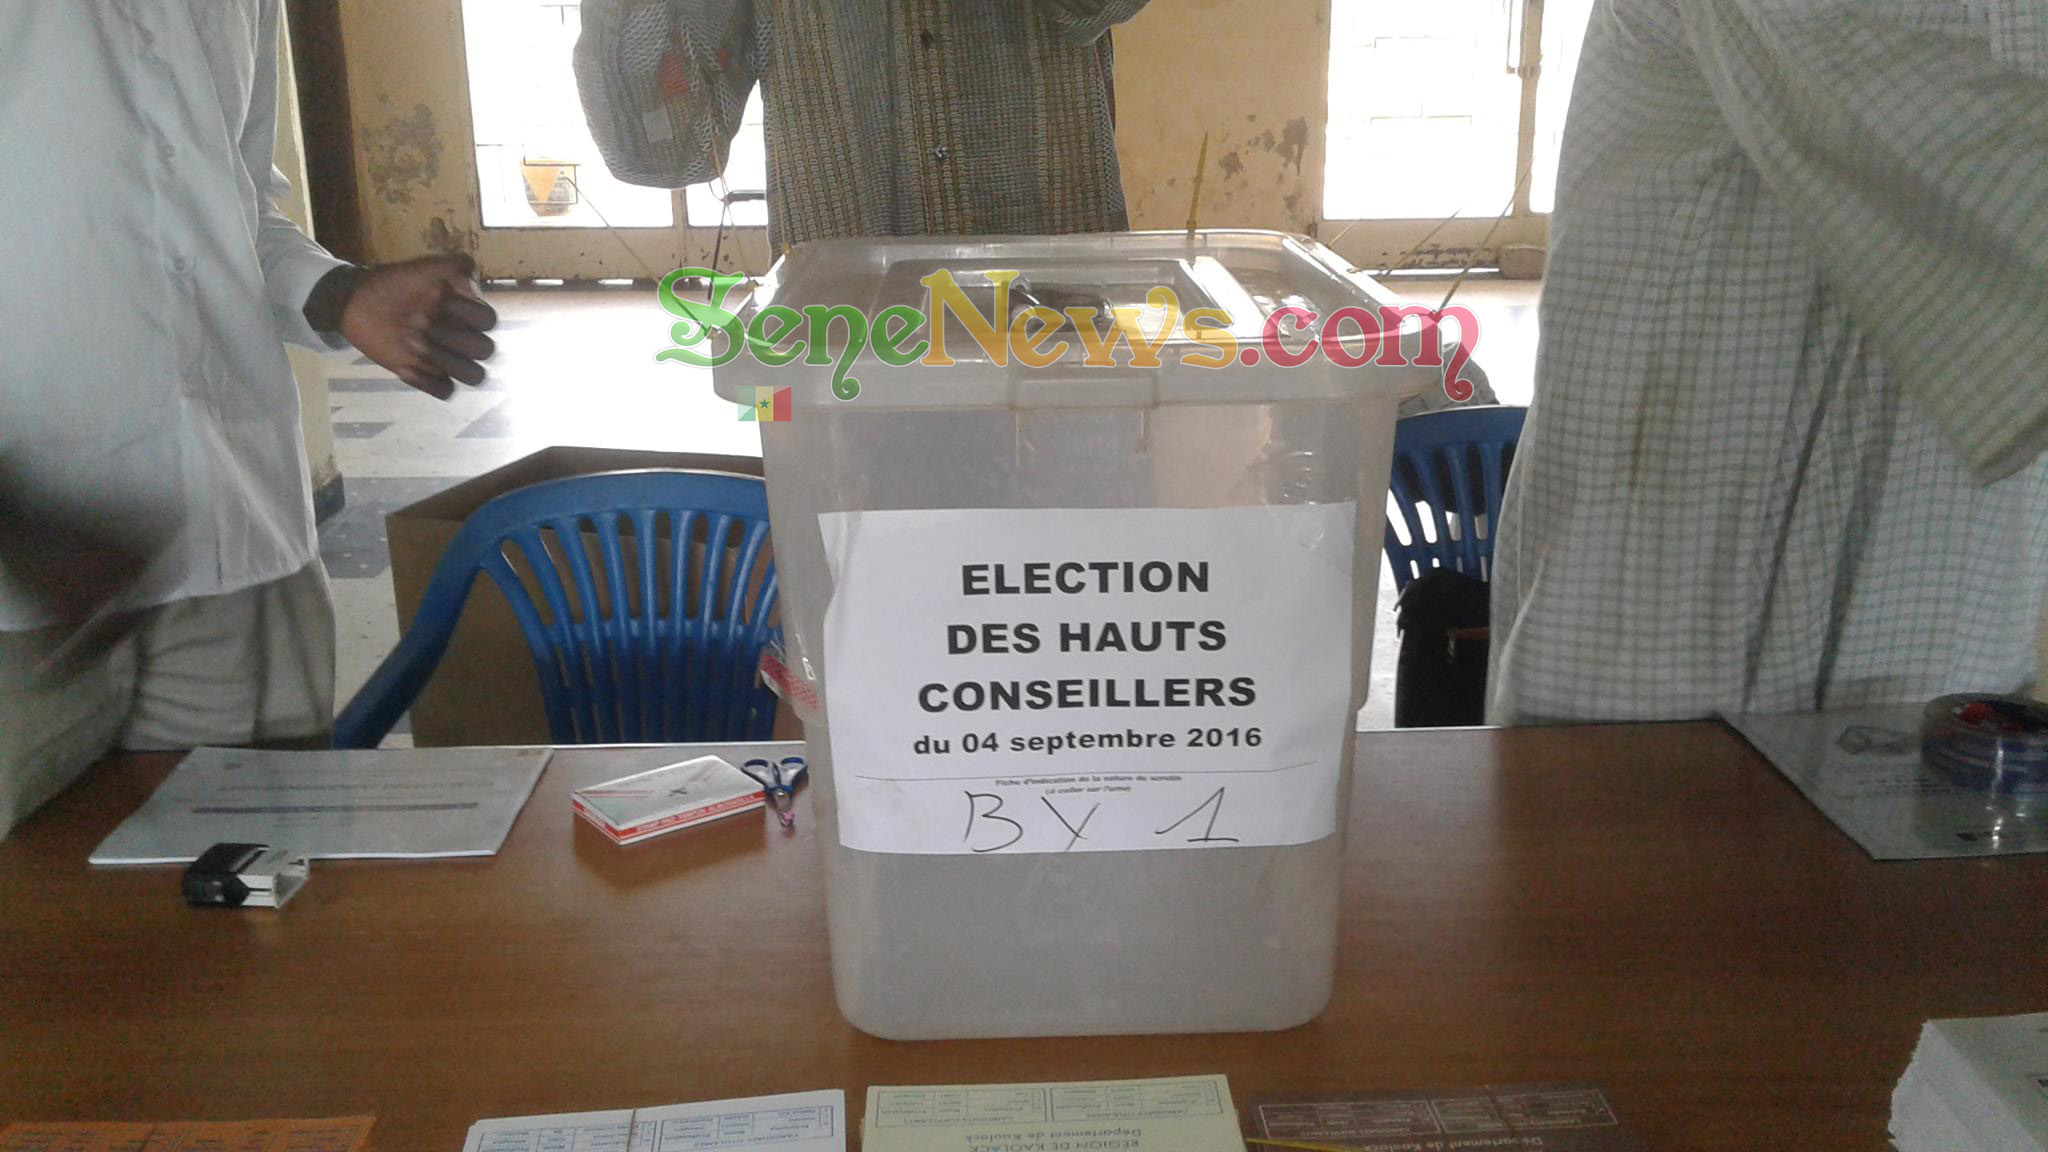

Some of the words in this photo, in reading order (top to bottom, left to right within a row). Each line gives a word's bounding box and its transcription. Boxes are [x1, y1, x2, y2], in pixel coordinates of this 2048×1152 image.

[961, 561, 1210, 595] ELECTION
[947, 623, 1040, 655] DES
[1059, 620, 1227, 652] HAUTS
[918, 676, 1257, 713] CONSEILLERS
[913, 735, 951, 755] du
[962, 732, 999, 753] 04
[1009, 729, 1176, 755] septembre
[1186, 727, 1263, 748] 2016
[1155, 787, 1239, 843] 1
[965, 1133, 1022, 1143] Kaolack
